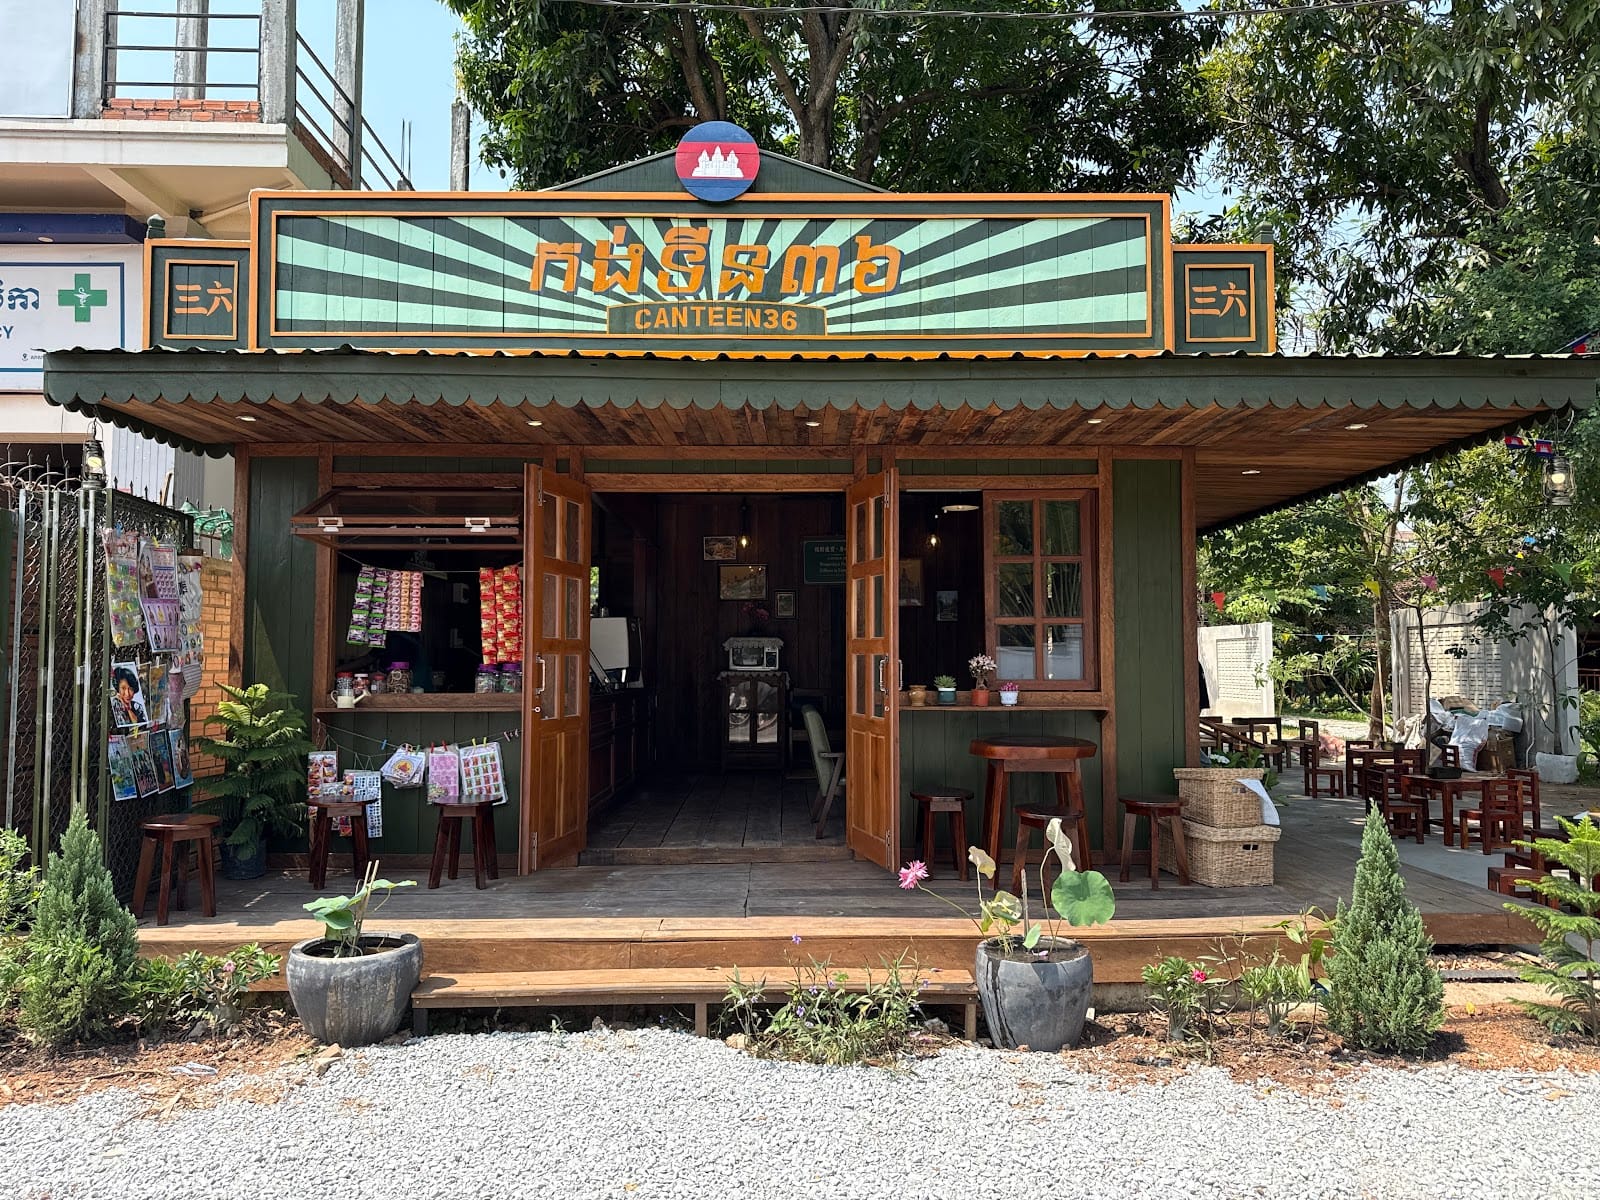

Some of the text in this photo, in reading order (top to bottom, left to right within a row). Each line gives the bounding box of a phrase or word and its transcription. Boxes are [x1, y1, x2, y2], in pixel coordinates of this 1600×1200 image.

[174, 280, 233, 316] 三六
[1190, 281, 1247, 318] 三六
[634, 306, 798, 331] CANTEEN36
